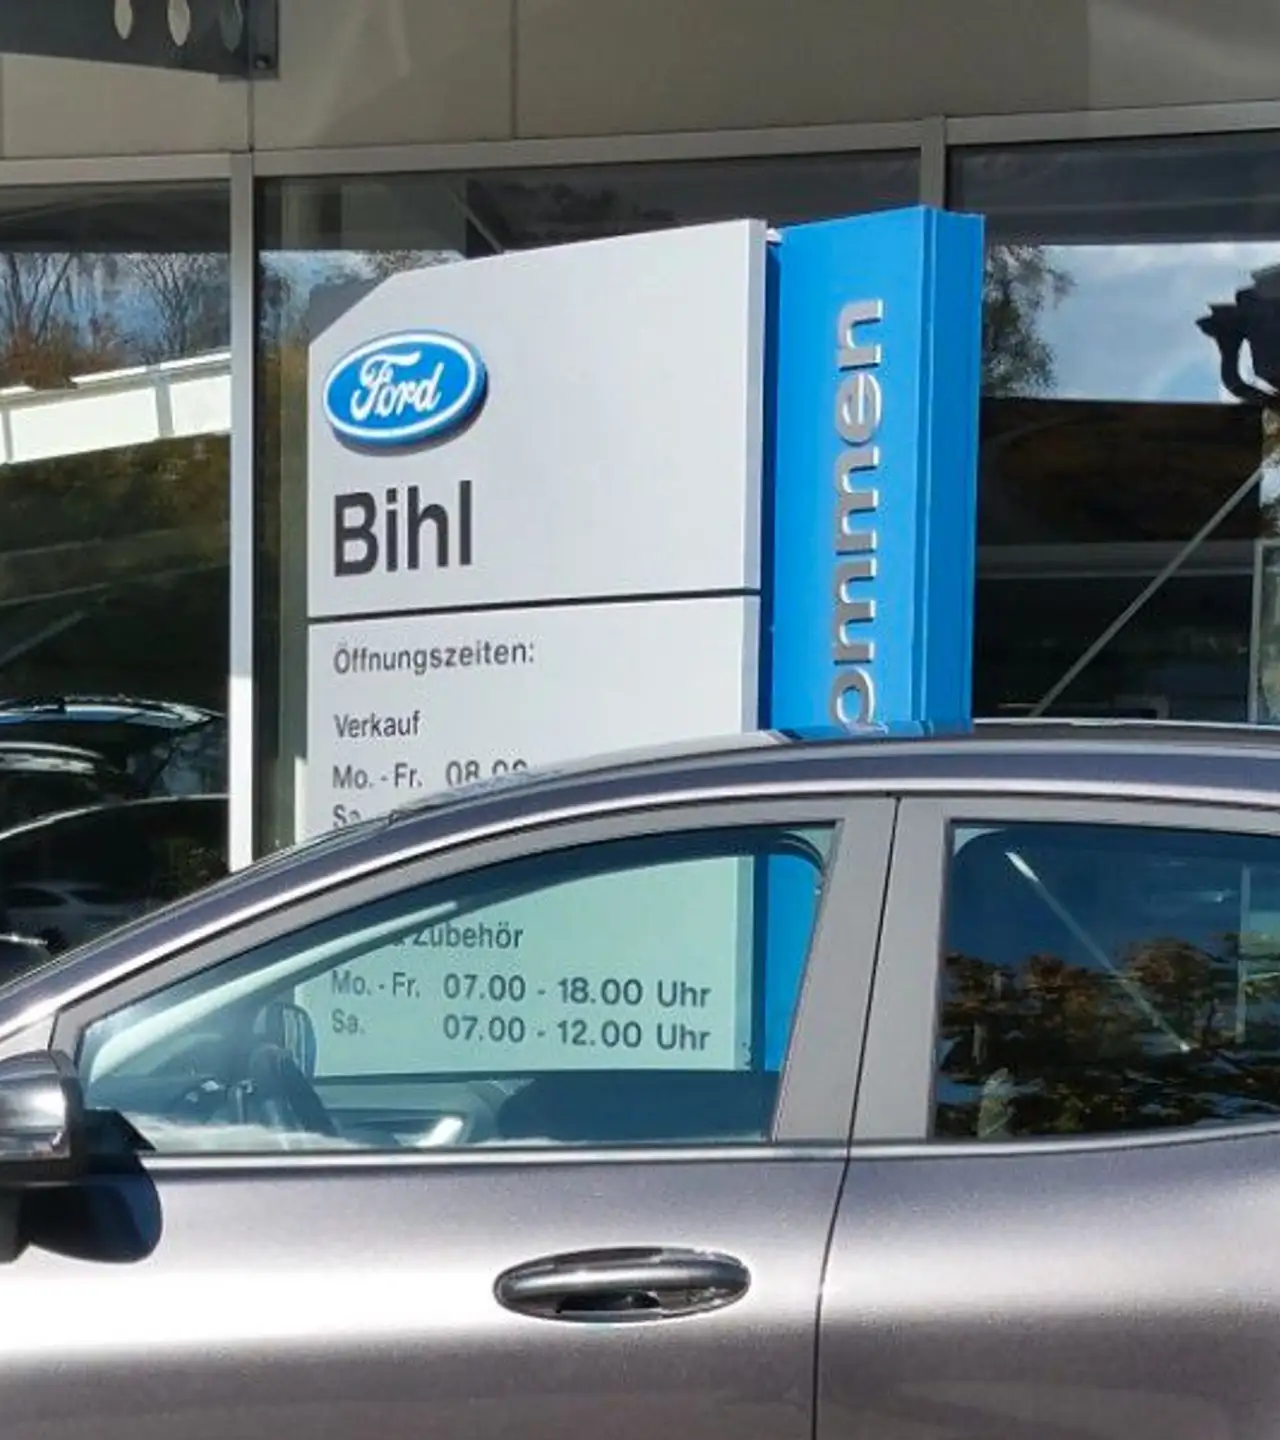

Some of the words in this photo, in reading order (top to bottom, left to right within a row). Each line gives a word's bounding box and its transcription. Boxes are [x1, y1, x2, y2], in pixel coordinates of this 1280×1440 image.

[350, 350, 445, 421] Ford
[333, 479, 473, 577] Bihl
[333, 639, 536, 676] Öffnungszeiten:
[333, 710, 421, 739] Verkauf
[331, 764, 374, 789] Mo.
[393, 761, 423, 788] Fr.
[331, 969, 372, 997] Mo.
[392, 971, 421, 998] Fr.
[443, 973, 526, 1002] 07.00
[557, 976, 644, 1006] 18.00
[657, 979, 712, 1008] Uhr
[331, 1008, 366, 1036] Sa.
[442, 1013, 526, 1043] 07.00
[557, 1019, 643, 1048] 12.00
[656, 1022, 712, 1051] Uhr
